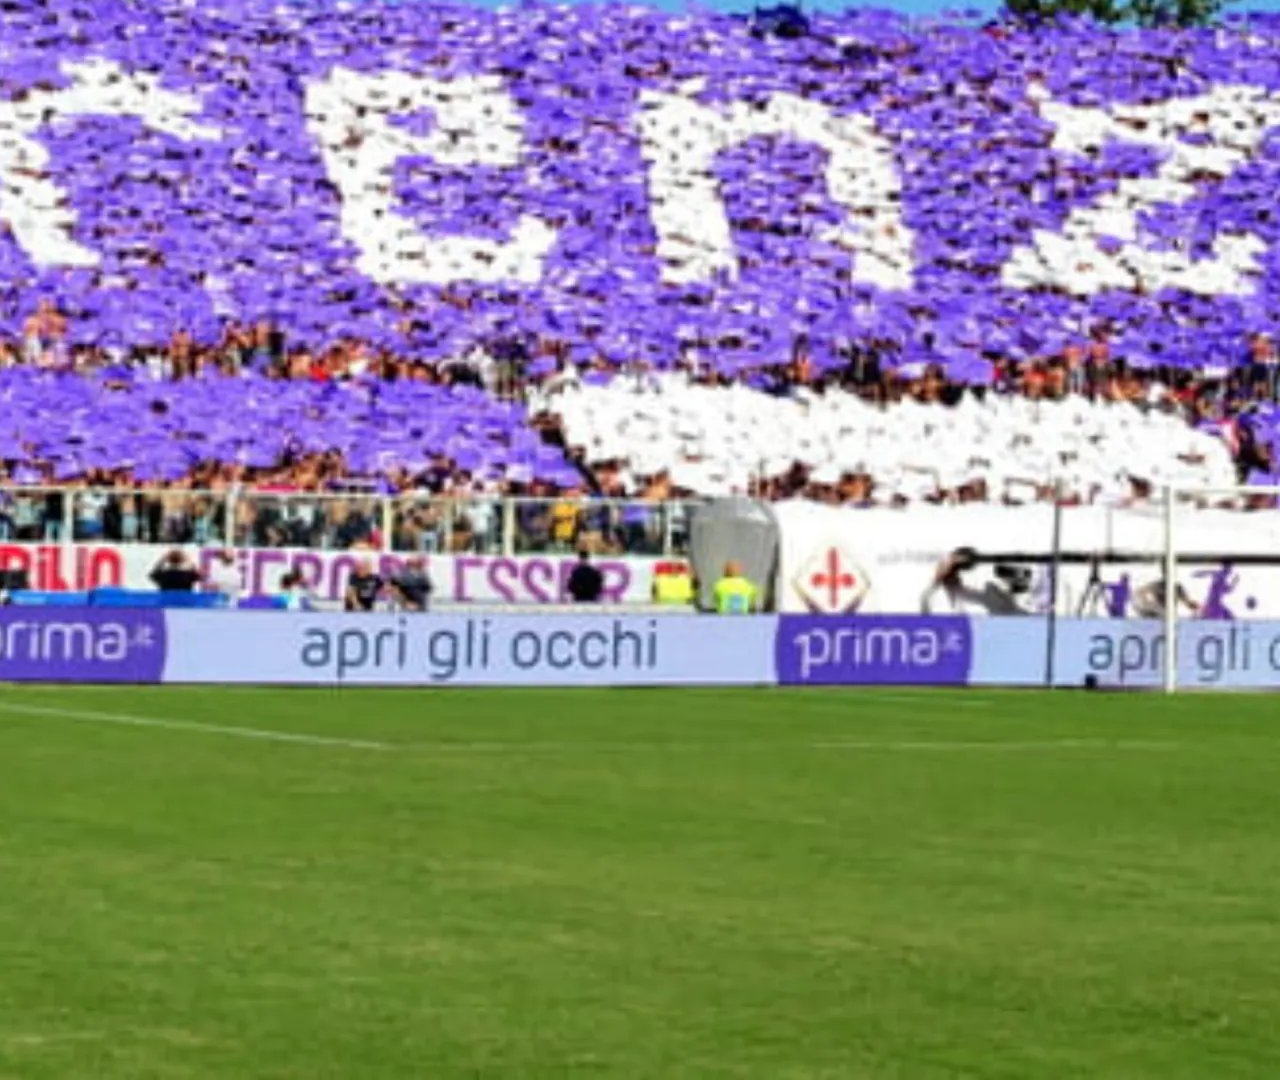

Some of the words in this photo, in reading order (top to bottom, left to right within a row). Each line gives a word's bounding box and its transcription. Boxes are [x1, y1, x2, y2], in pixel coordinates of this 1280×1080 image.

[300, 618, 408, 679] apri
[427, 618, 491, 681] gli
[510, 618, 658, 669] occhi
[1088, 632, 1168, 678] apr
[1196, 627, 1252, 682] gli
